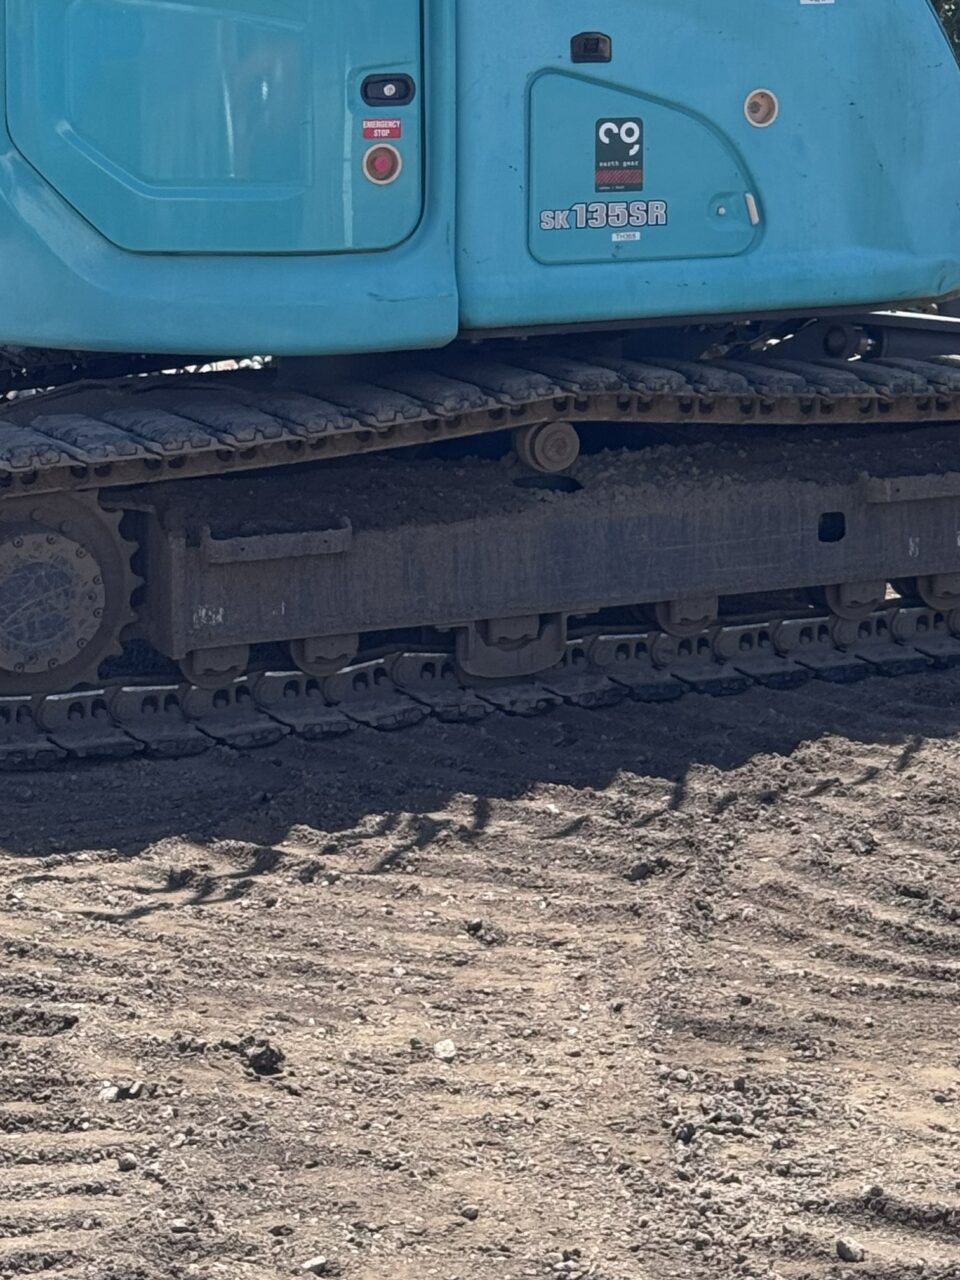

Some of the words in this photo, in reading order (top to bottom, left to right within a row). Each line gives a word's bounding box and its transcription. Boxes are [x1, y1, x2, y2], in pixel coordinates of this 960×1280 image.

[363, 120, 401, 129] EMERGENCY
[373, 129, 390, 137] STOP
[540, 200, 667, 230] SK135SR
